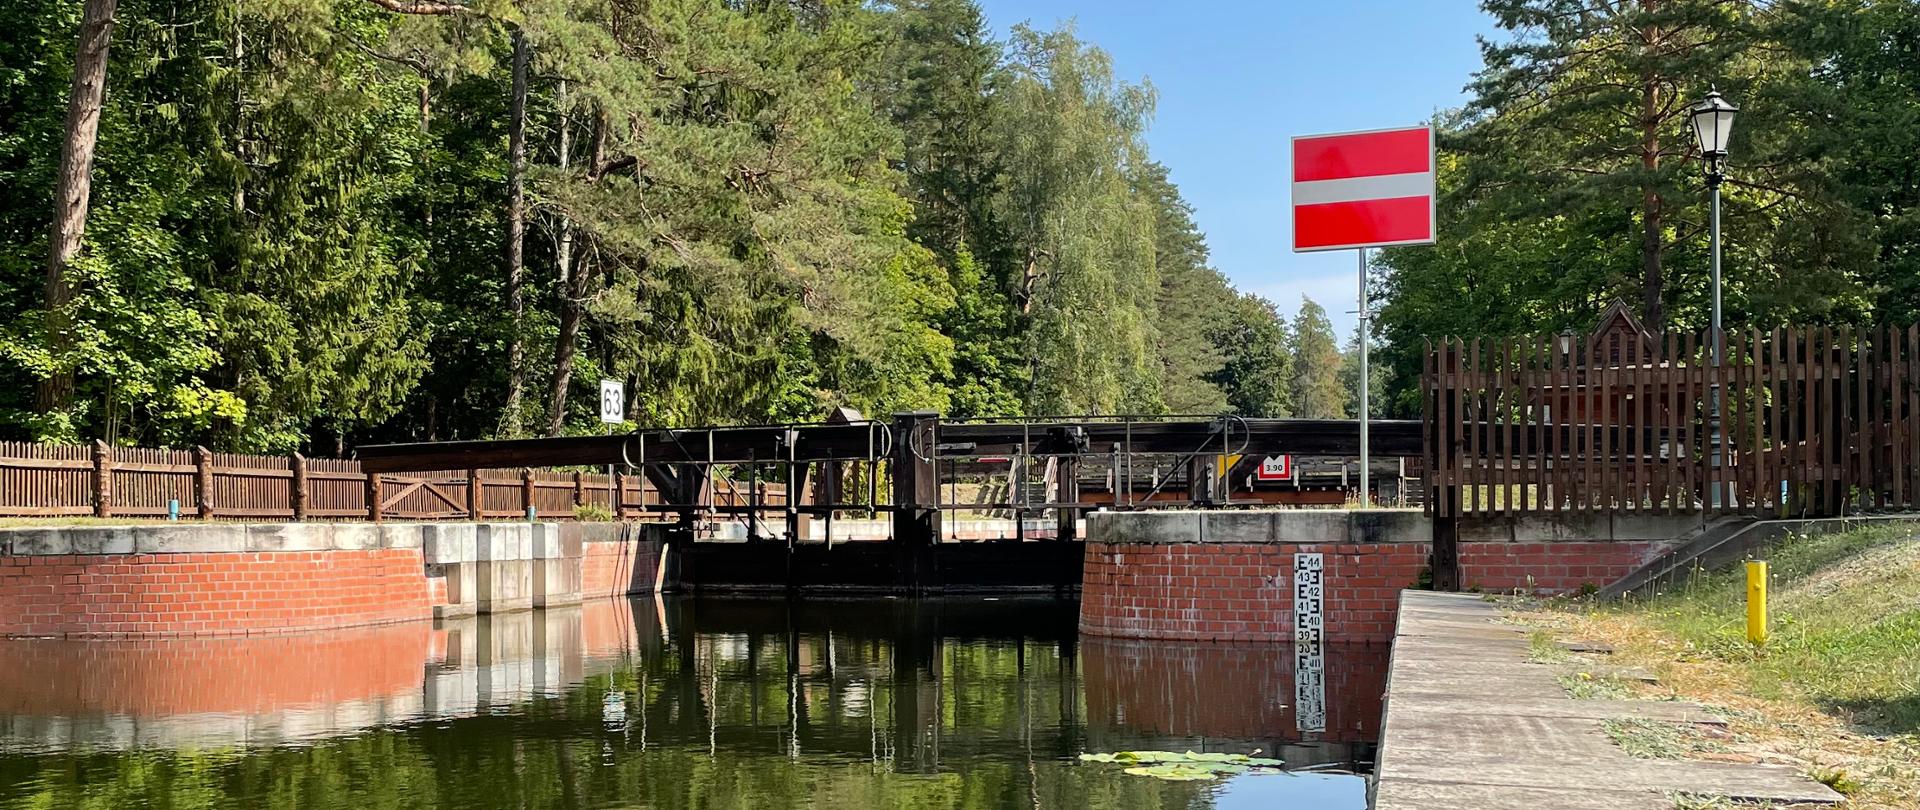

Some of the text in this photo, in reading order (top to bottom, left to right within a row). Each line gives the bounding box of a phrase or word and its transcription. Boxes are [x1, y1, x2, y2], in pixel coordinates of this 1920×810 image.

[604, 388, 621, 416] 63
[1266, 464, 1283, 472] 3.90
[1308, 557, 1320, 567] 44
[1298, 572, 1310, 582] 43
[1308, 587, 1320, 597] 42
[1298, 601, 1309, 611] 41
[1308, 616, 1320, 626] 40
[1298, 630, 1310, 640] 39
